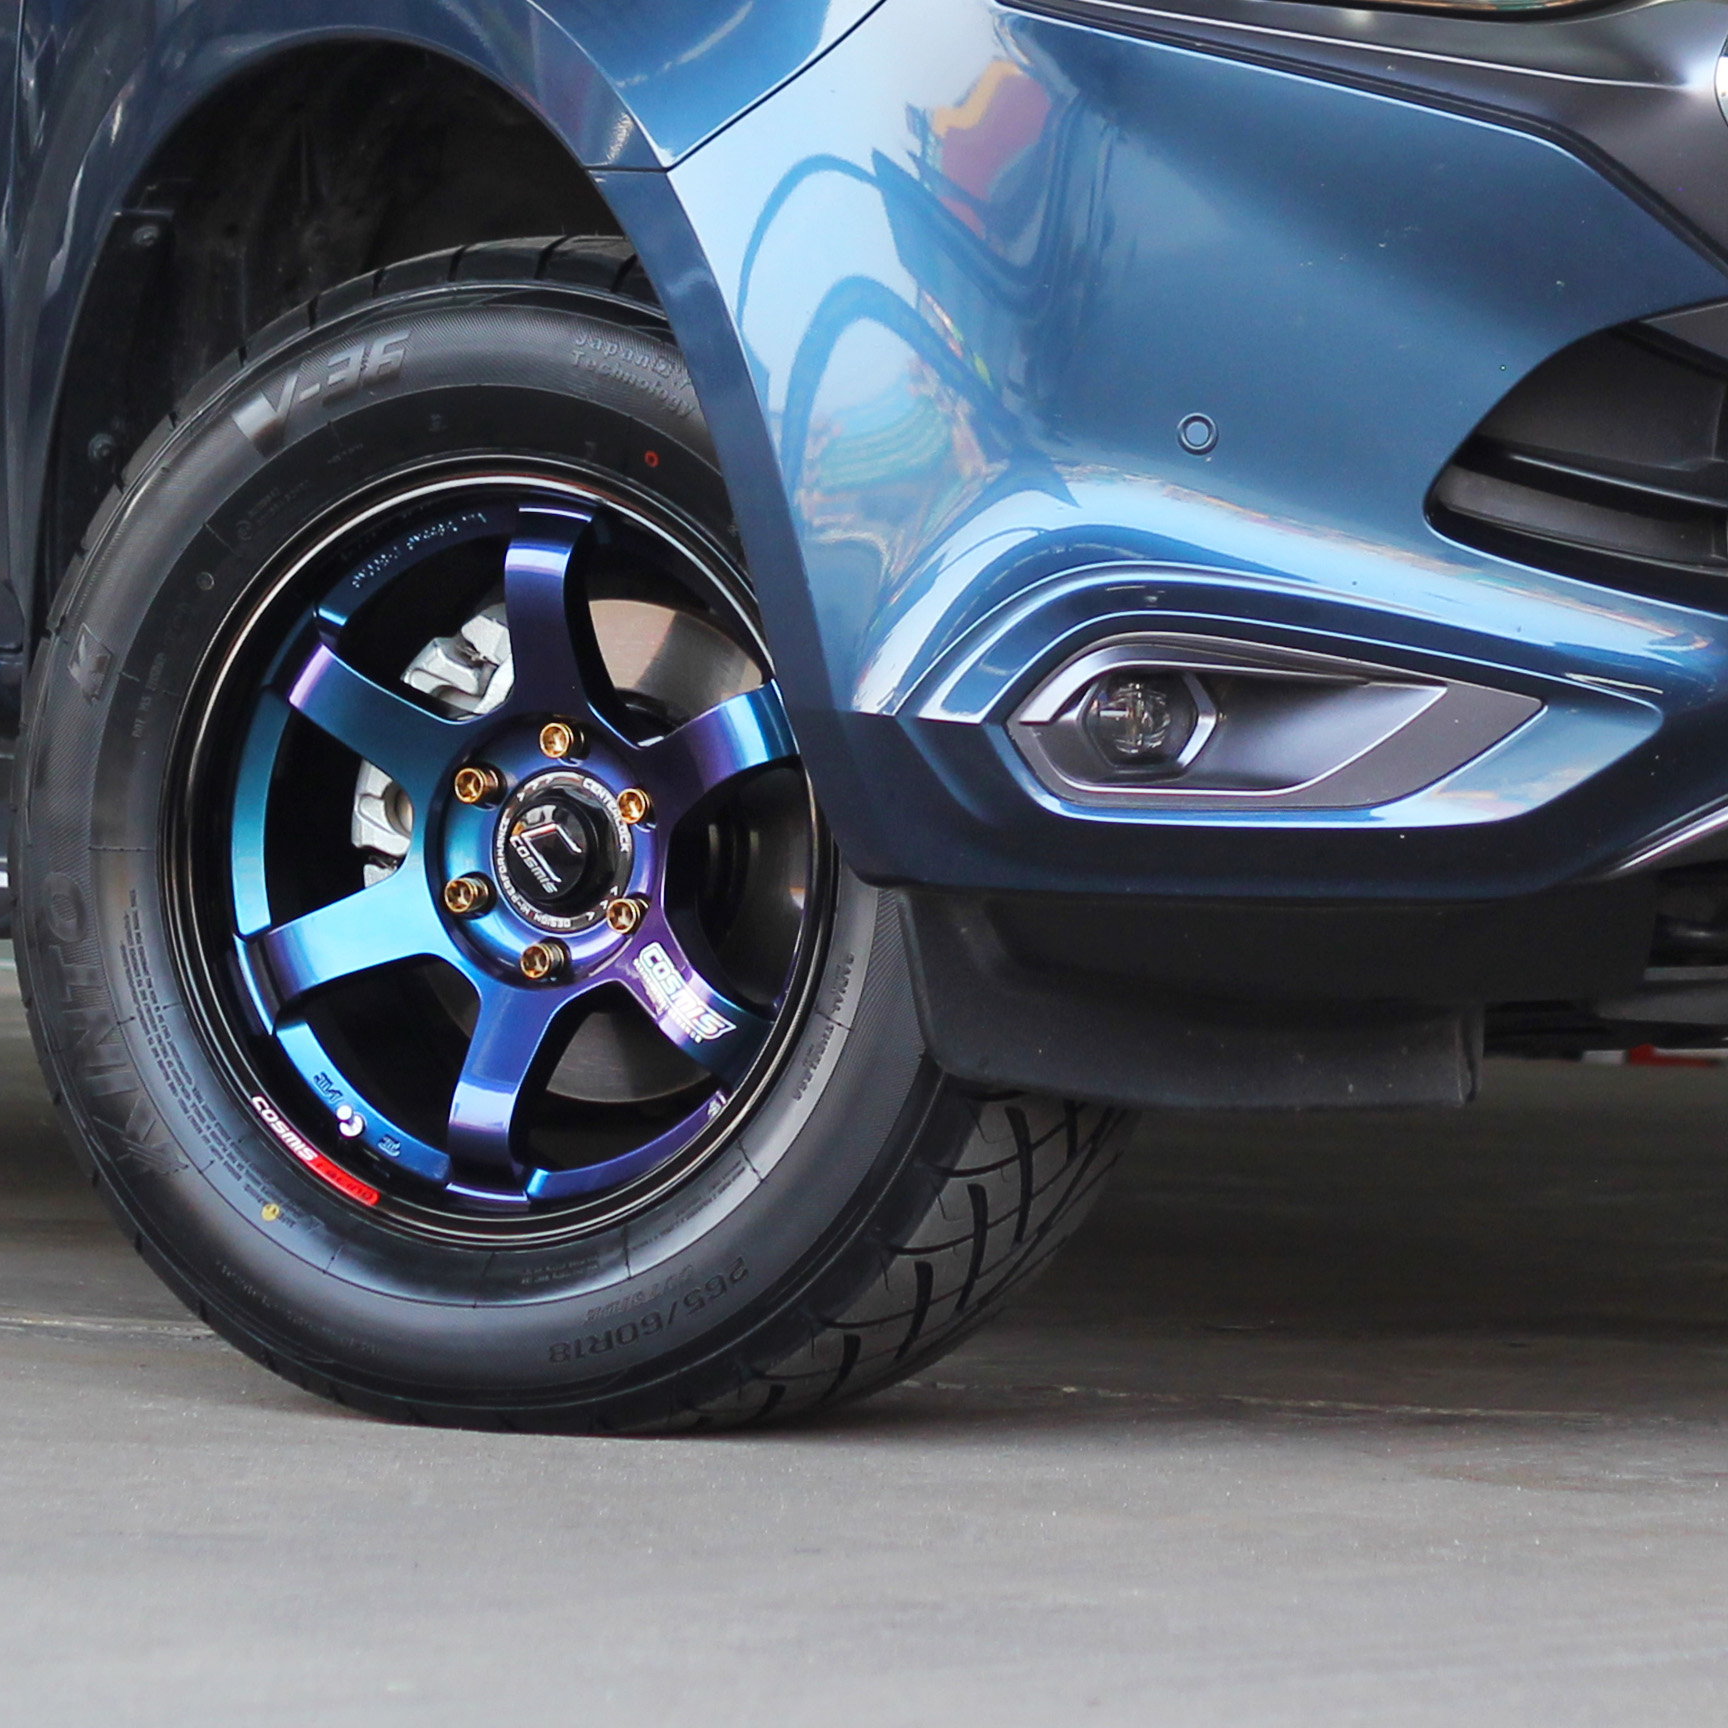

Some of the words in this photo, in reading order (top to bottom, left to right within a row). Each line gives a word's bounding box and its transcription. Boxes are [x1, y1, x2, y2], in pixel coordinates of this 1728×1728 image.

[641, 948, 728, 1037] COSMIS
[251, 1094, 320, 1162] COSMIS
[546, 1255, 752, 1363] 265/60R18
